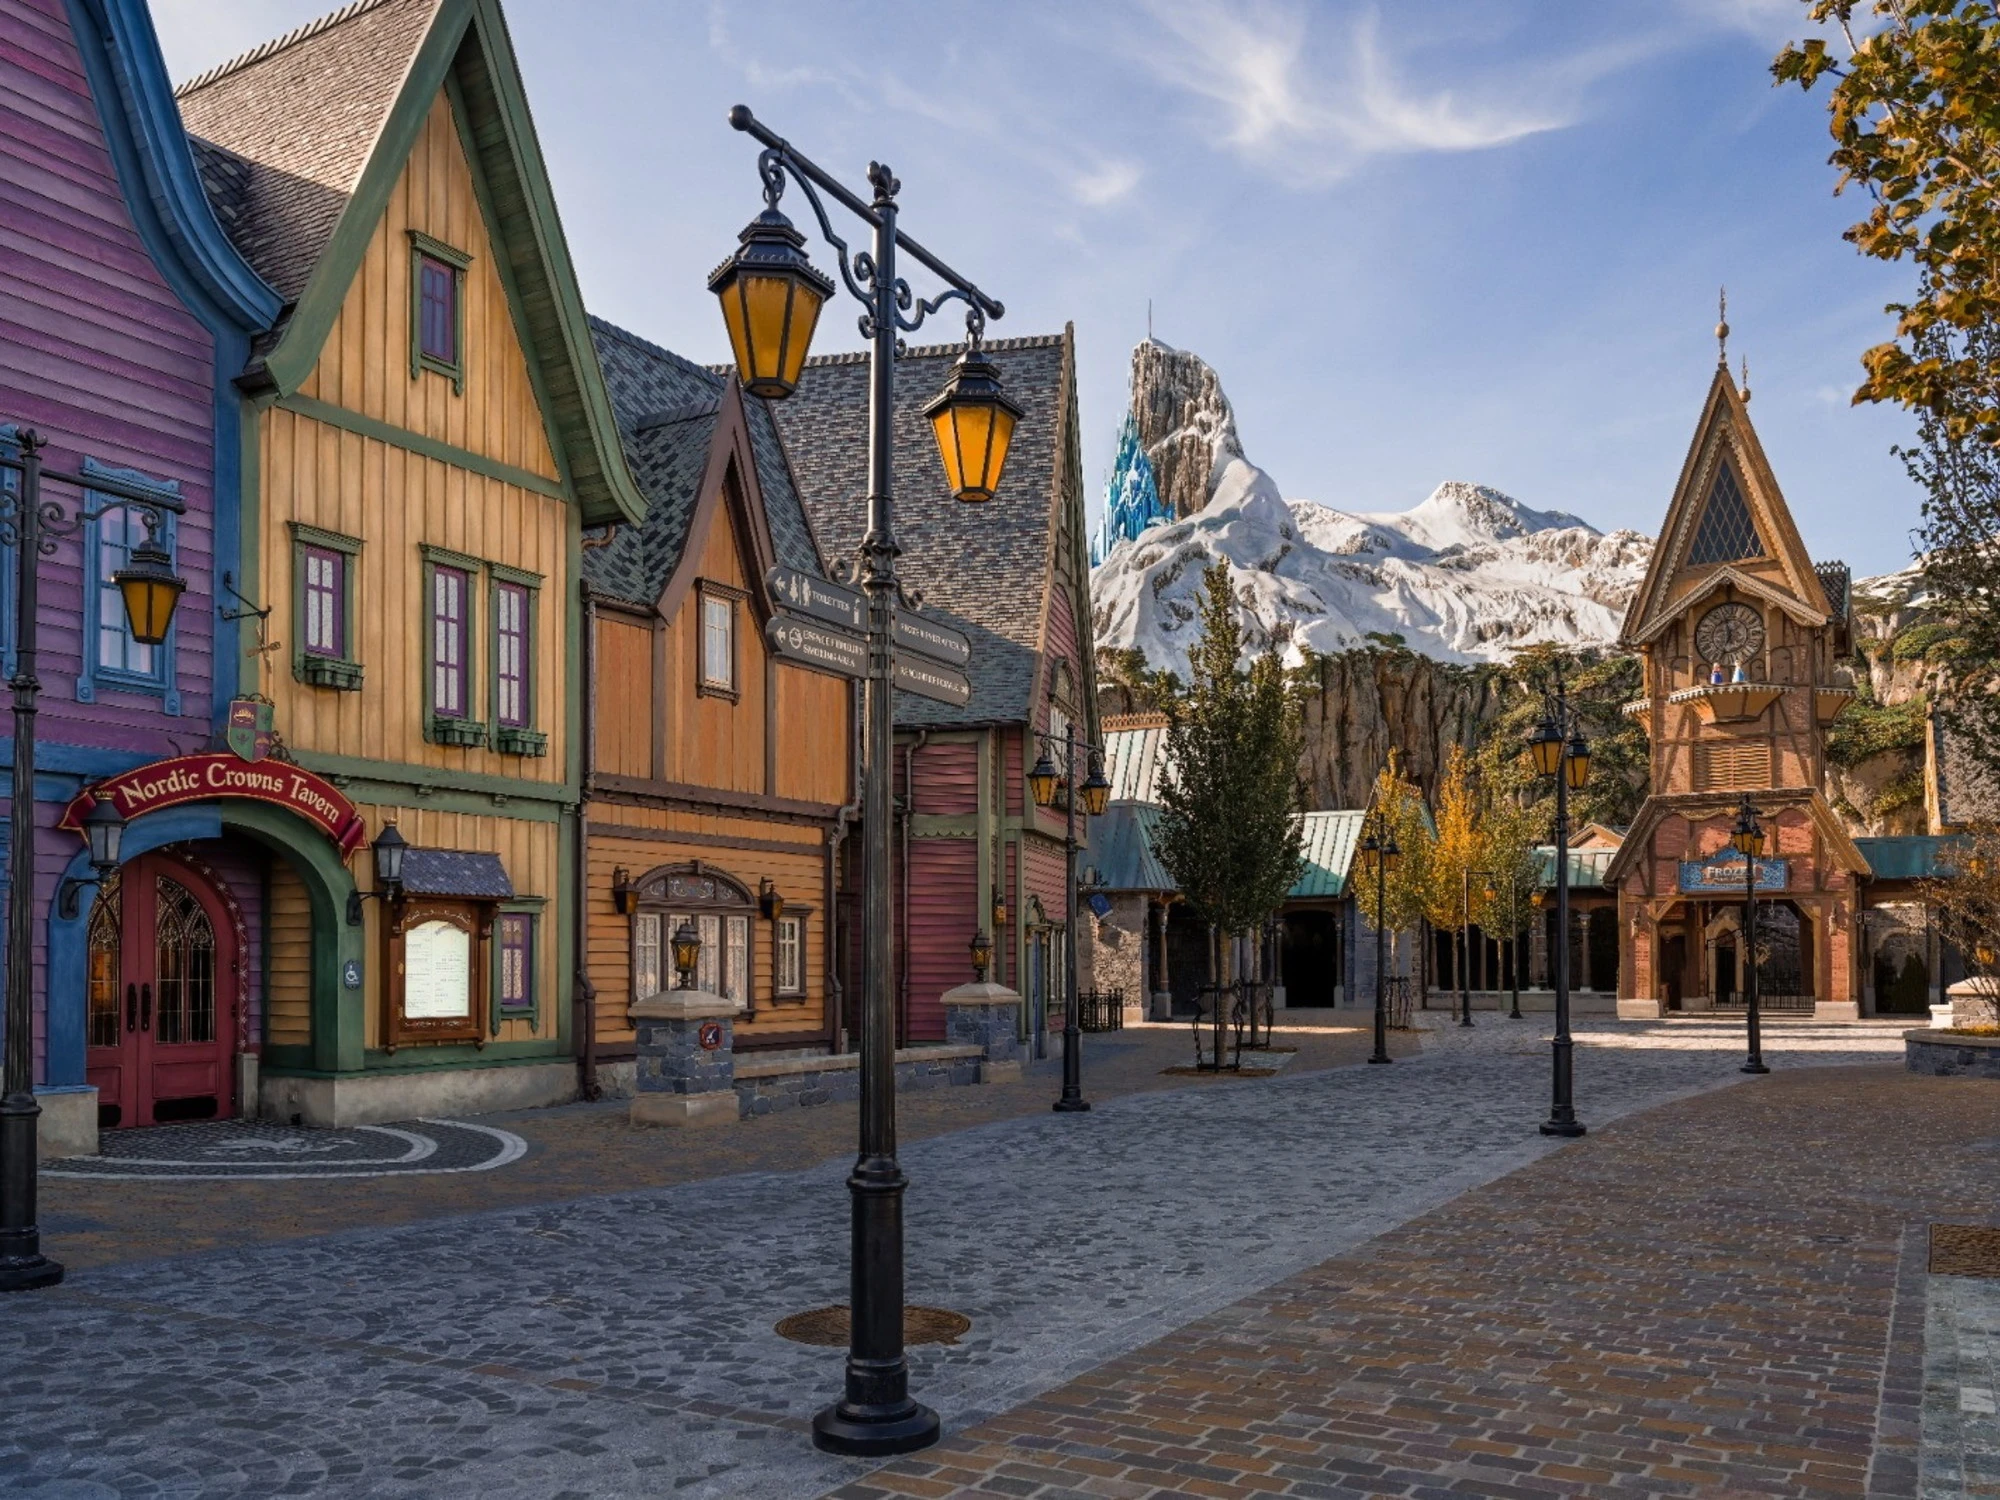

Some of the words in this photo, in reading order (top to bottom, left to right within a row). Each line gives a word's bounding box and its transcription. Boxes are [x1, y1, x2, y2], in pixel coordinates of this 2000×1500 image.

[811, 590, 851, 612] TOILETTES
[118, 768, 200, 809] Nordic
[206, 762, 284, 793] Crowns
[290, 774, 341, 824] Tavern
[1707, 864, 1757, 877] FROZE
